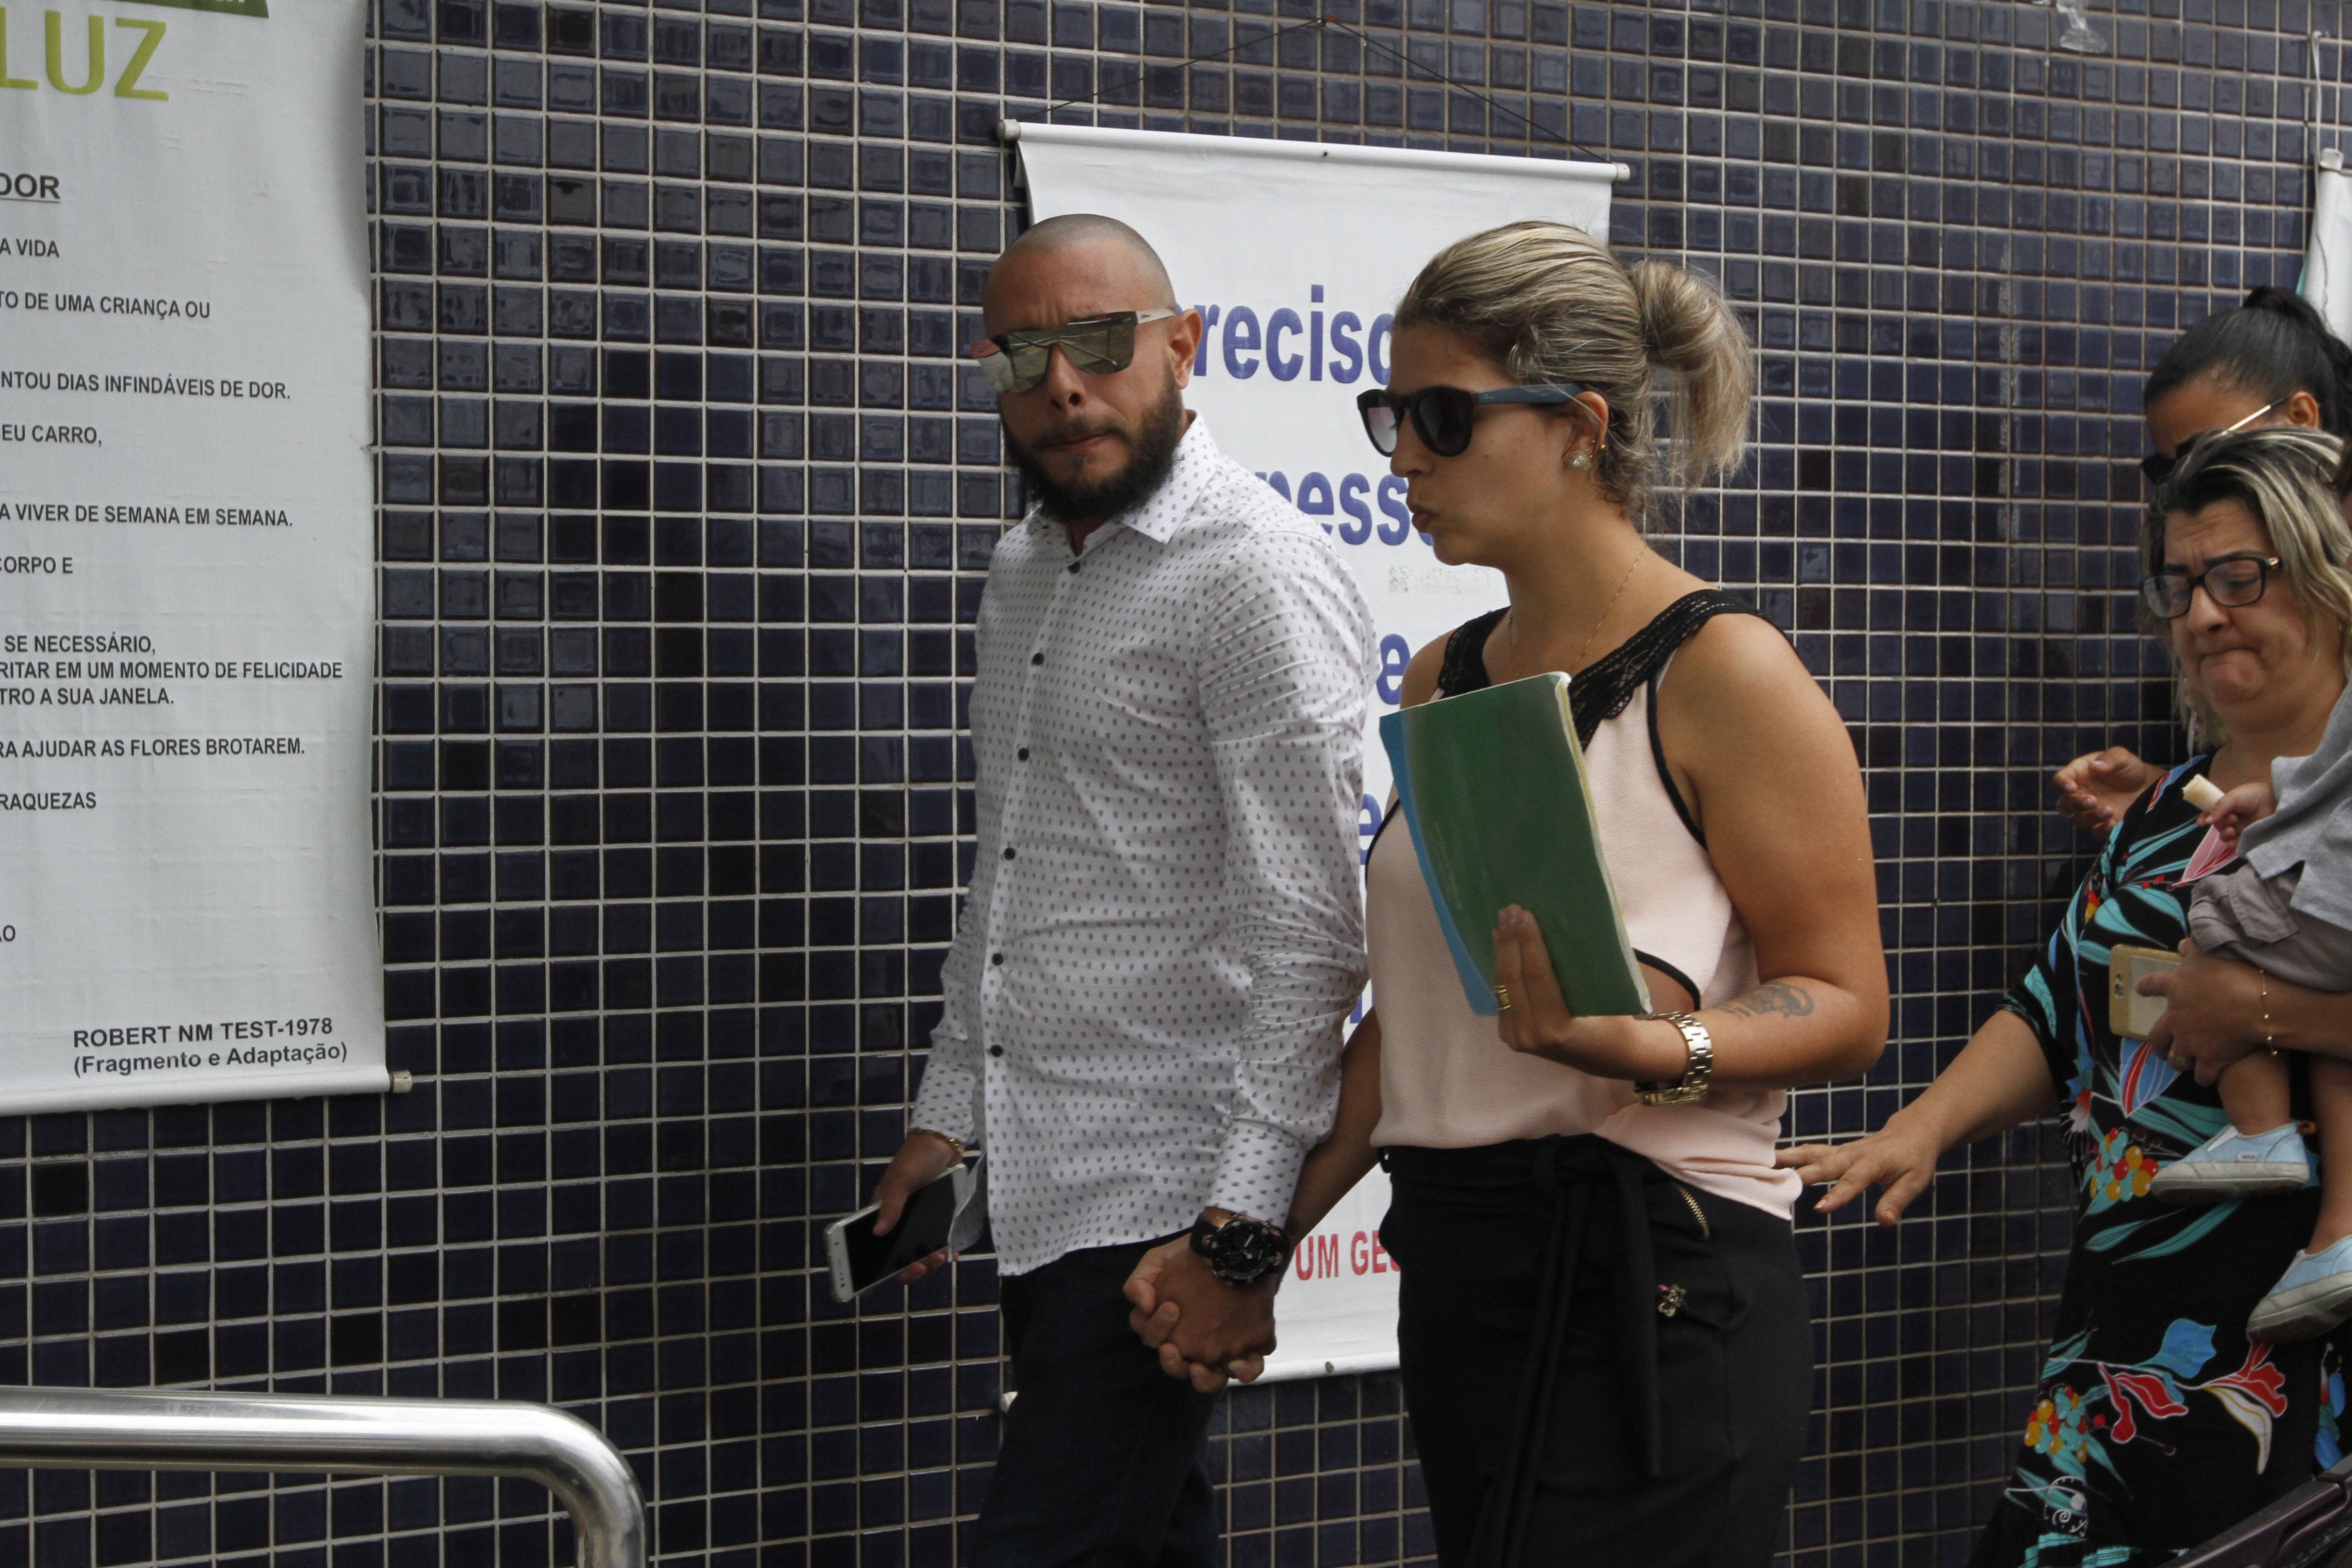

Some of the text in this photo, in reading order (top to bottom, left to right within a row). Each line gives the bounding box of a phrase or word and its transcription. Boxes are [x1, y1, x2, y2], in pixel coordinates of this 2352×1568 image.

[0, 6, 169, 101] LUZ
[16, 239, 59, 257] VIDA
[25, 293, 49, 310] DE
[56, 294, 95, 312] UMA
[100, 296, 180, 320] CRIANÇA
[185, 301, 210, 318] OU
[1176, 284, 1394, 385] reciso
[1, 371, 291, 399] NTOU DIAS INFINDÁVEIS DE DOR.
[32, 425, 102, 446] CARRO,
[16, 504, 69, 521] VIVER
[76, 506, 99, 523] DE
[105, 506, 180, 524] SEMANA
[186, 508, 210, 525] EM
[216, 508, 293, 527] SEMANA.
[0, 556, 74, 574] ORPO E
[5, 632, 156, 656] SE NECESSÁRIO,
[56, 662, 81, 679] EM
[88, 662, 114, 679] UM
[120, 662, 210, 679] MOMENTO
[216, 662, 238, 679] DE
[244, 662, 342, 679] FELICIDADE
[40, 688, 52, 705] A
[58, 688, 94, 705] SUA
[99, 687, 174, 705] JANELA.
[22, 740, 97, 757] AJUDAR
[101, 740, 125, 757] AS
[131, 739, 200, 756] FLORES
[206, 738, 305, 755] BROTAREM.
[74, 1017, 333, 1047] ROBERT NM TEST-1978
[74, 1042, 347, 1078] (Fragmento e Adaptação)
[1295, 1229, 1401, 1281] UM GE
